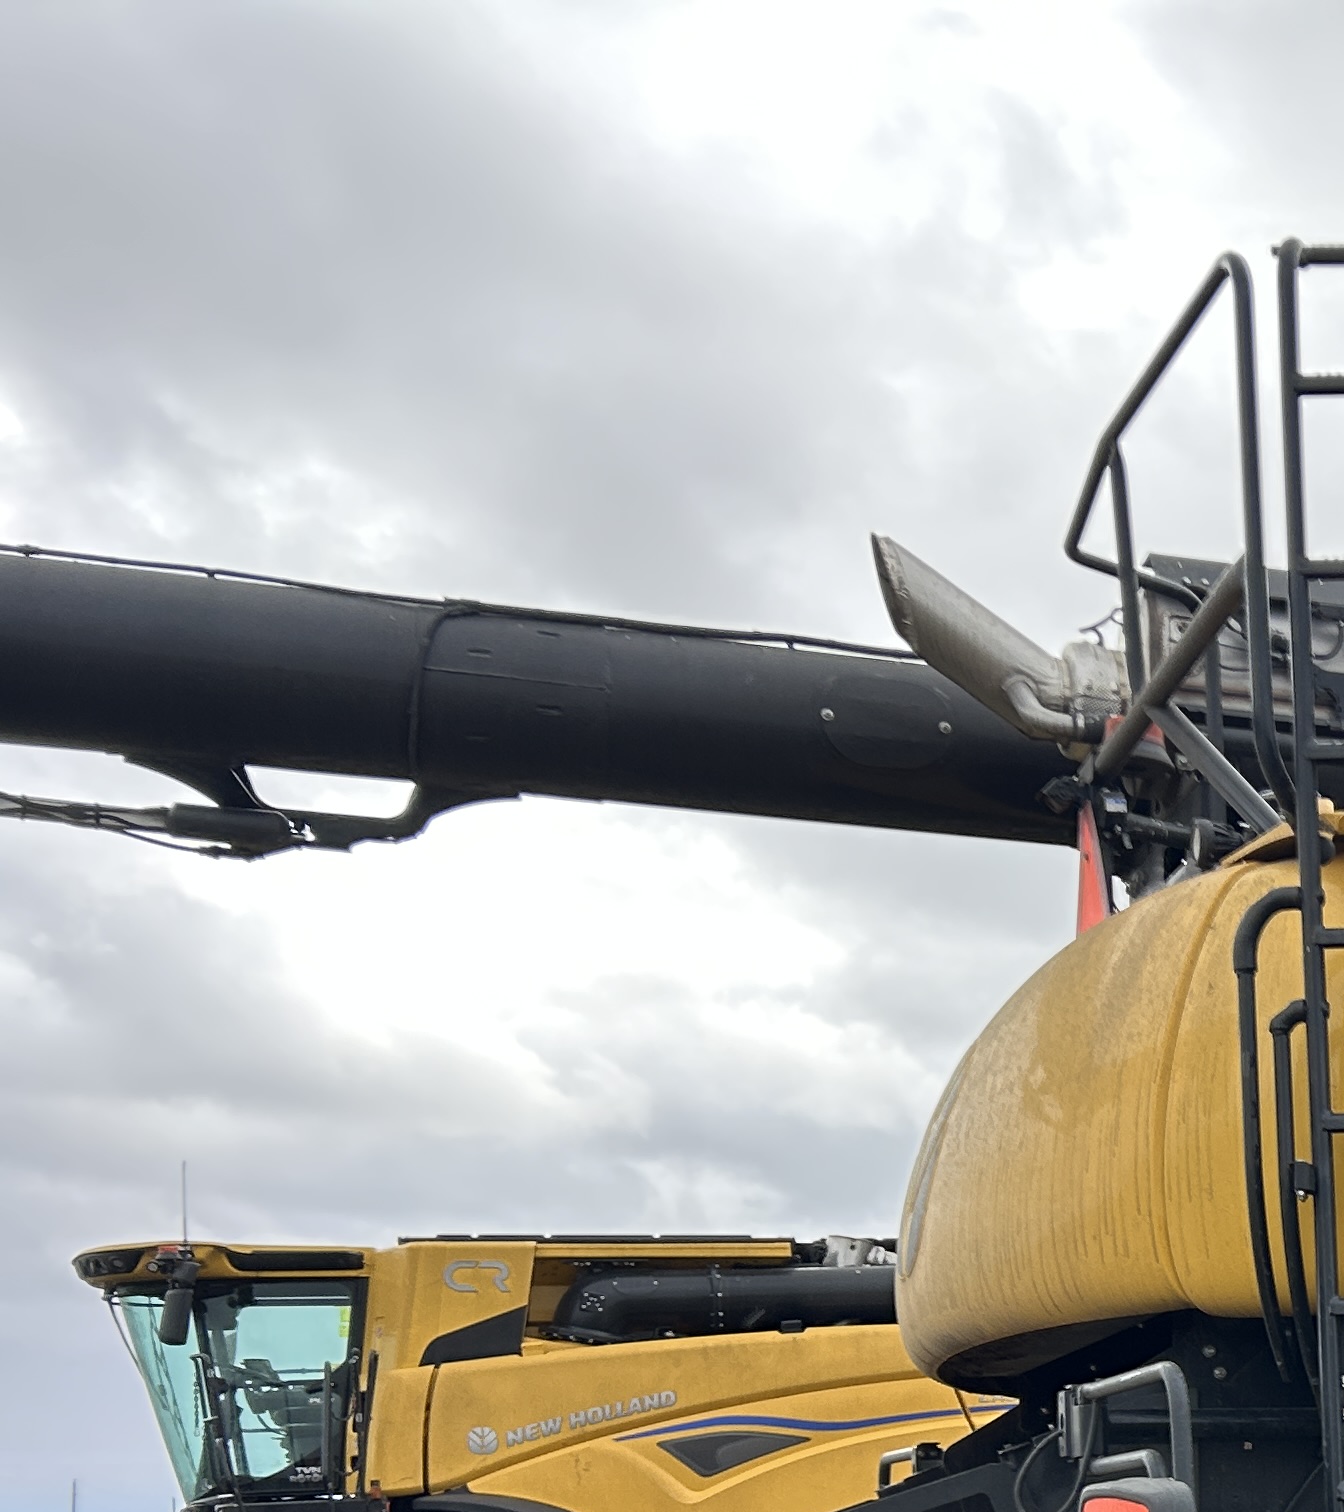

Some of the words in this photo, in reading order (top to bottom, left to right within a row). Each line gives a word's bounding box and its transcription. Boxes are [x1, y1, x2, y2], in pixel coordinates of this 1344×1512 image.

[443, 1260, 511, 1293] CR
[506, 1416, 563, 1448] NEW
[568, 1390, 678, 1429] HOLLAND
